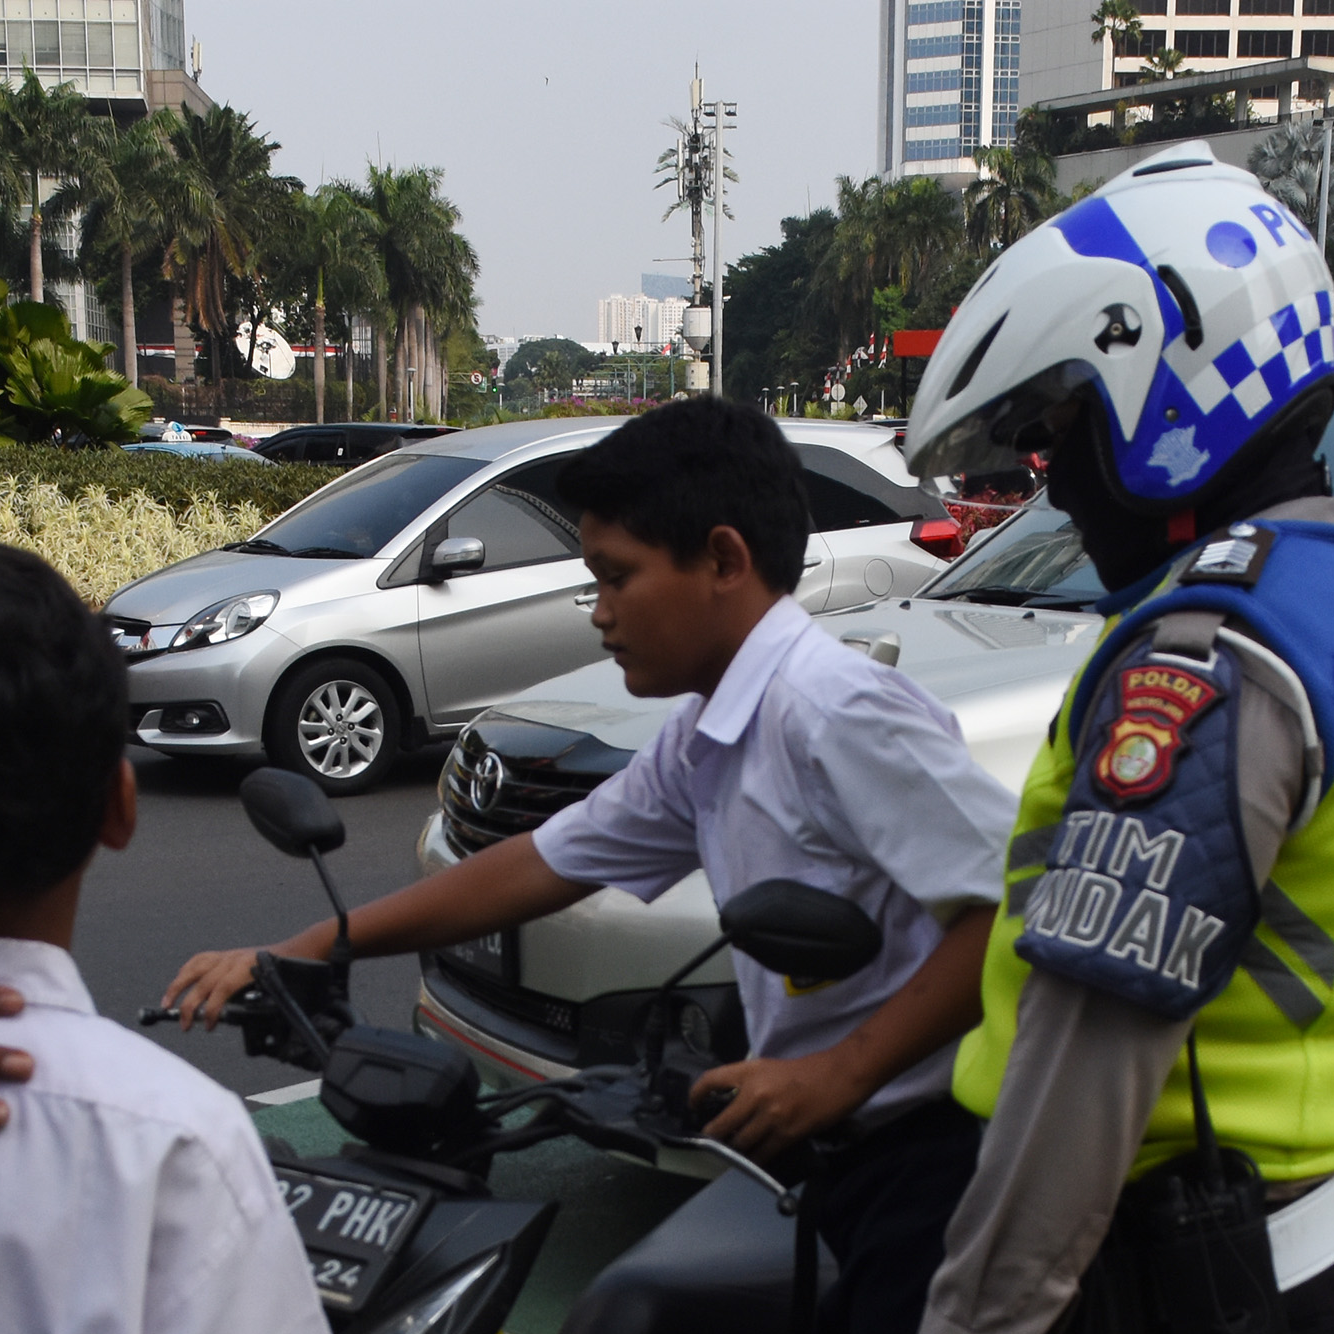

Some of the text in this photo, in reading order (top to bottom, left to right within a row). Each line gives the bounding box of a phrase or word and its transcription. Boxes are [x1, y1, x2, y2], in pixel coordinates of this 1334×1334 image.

[1128, 670, 1202, 703] POLDA
[1058, 811, 1186, 891] TIM
[1024, 867, 1226, 989] NDAK
[317, 1190, 406, 1246] PHK
